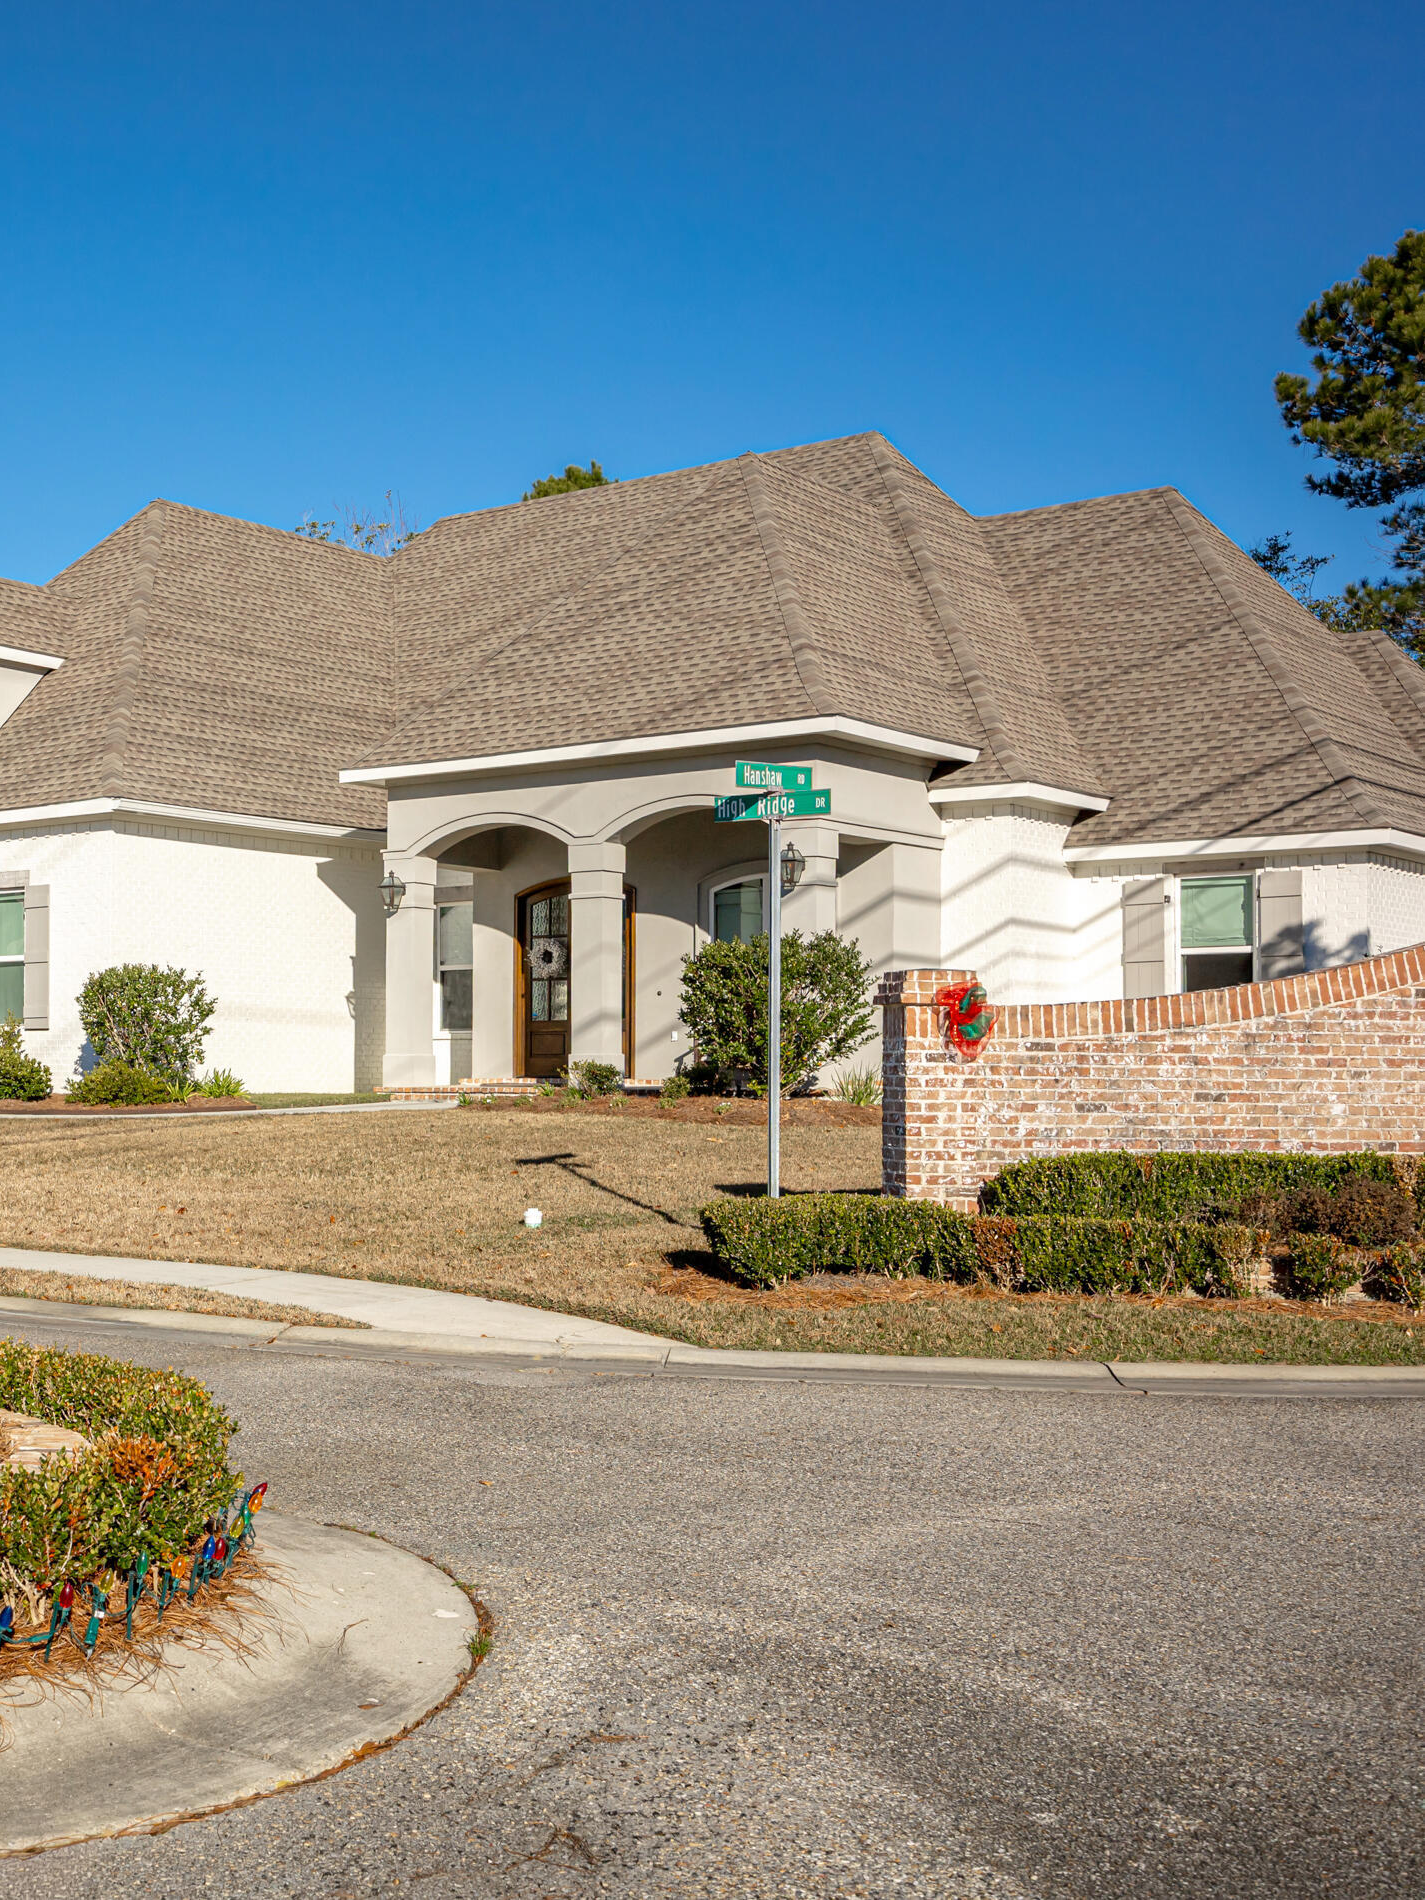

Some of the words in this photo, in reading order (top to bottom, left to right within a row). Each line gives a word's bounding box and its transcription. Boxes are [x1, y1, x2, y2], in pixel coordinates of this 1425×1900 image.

[744, 765, 782, 786] Hanshaw
[797, 773, 805, 785] RD
[718, 798, 746, 818] High
[758, 796, 795, 816] Ridge
[815, 797, 826, 808] DR
